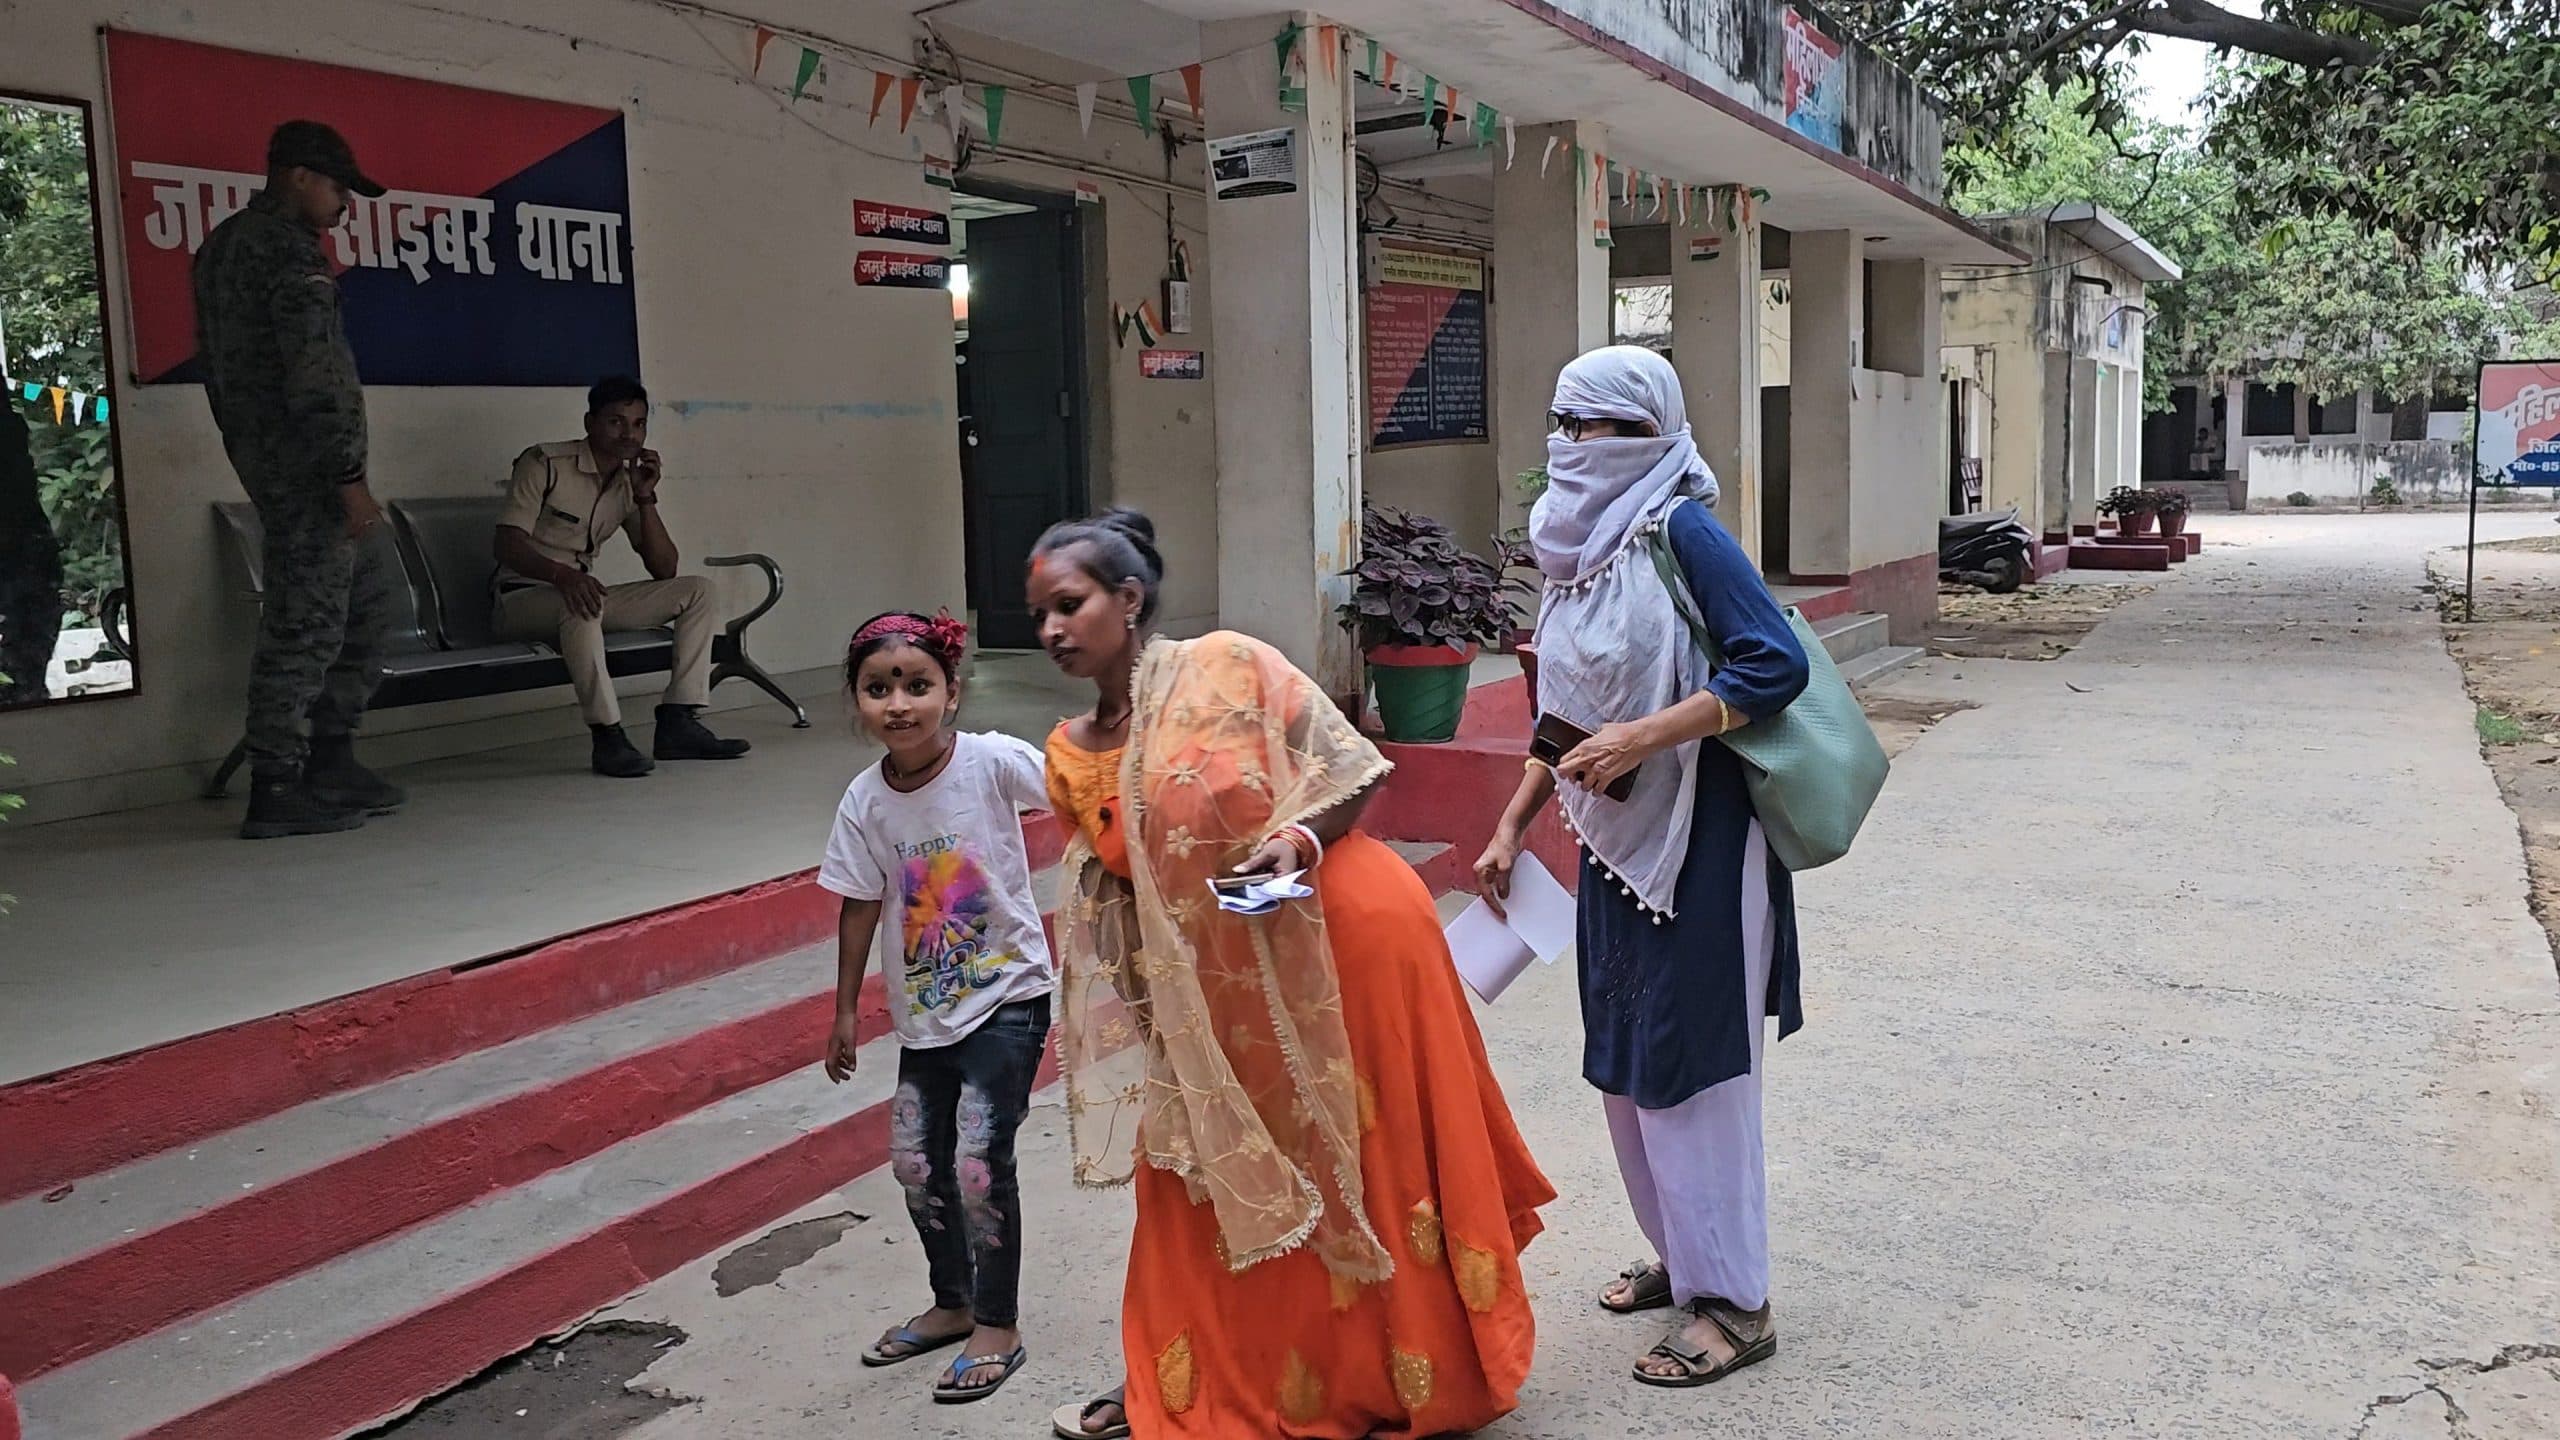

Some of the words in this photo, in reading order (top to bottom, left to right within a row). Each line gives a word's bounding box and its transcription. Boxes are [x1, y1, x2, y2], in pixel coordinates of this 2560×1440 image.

[860, 208, 887, 233] जमुई
[923, 220, 943, 234] थाना
[328, 187, 496, 286] साइबर
[514, 200, 624, 285] थाना
[860, 256, 887, 281] जमुई
[922, 263, 943, 278] थाना
